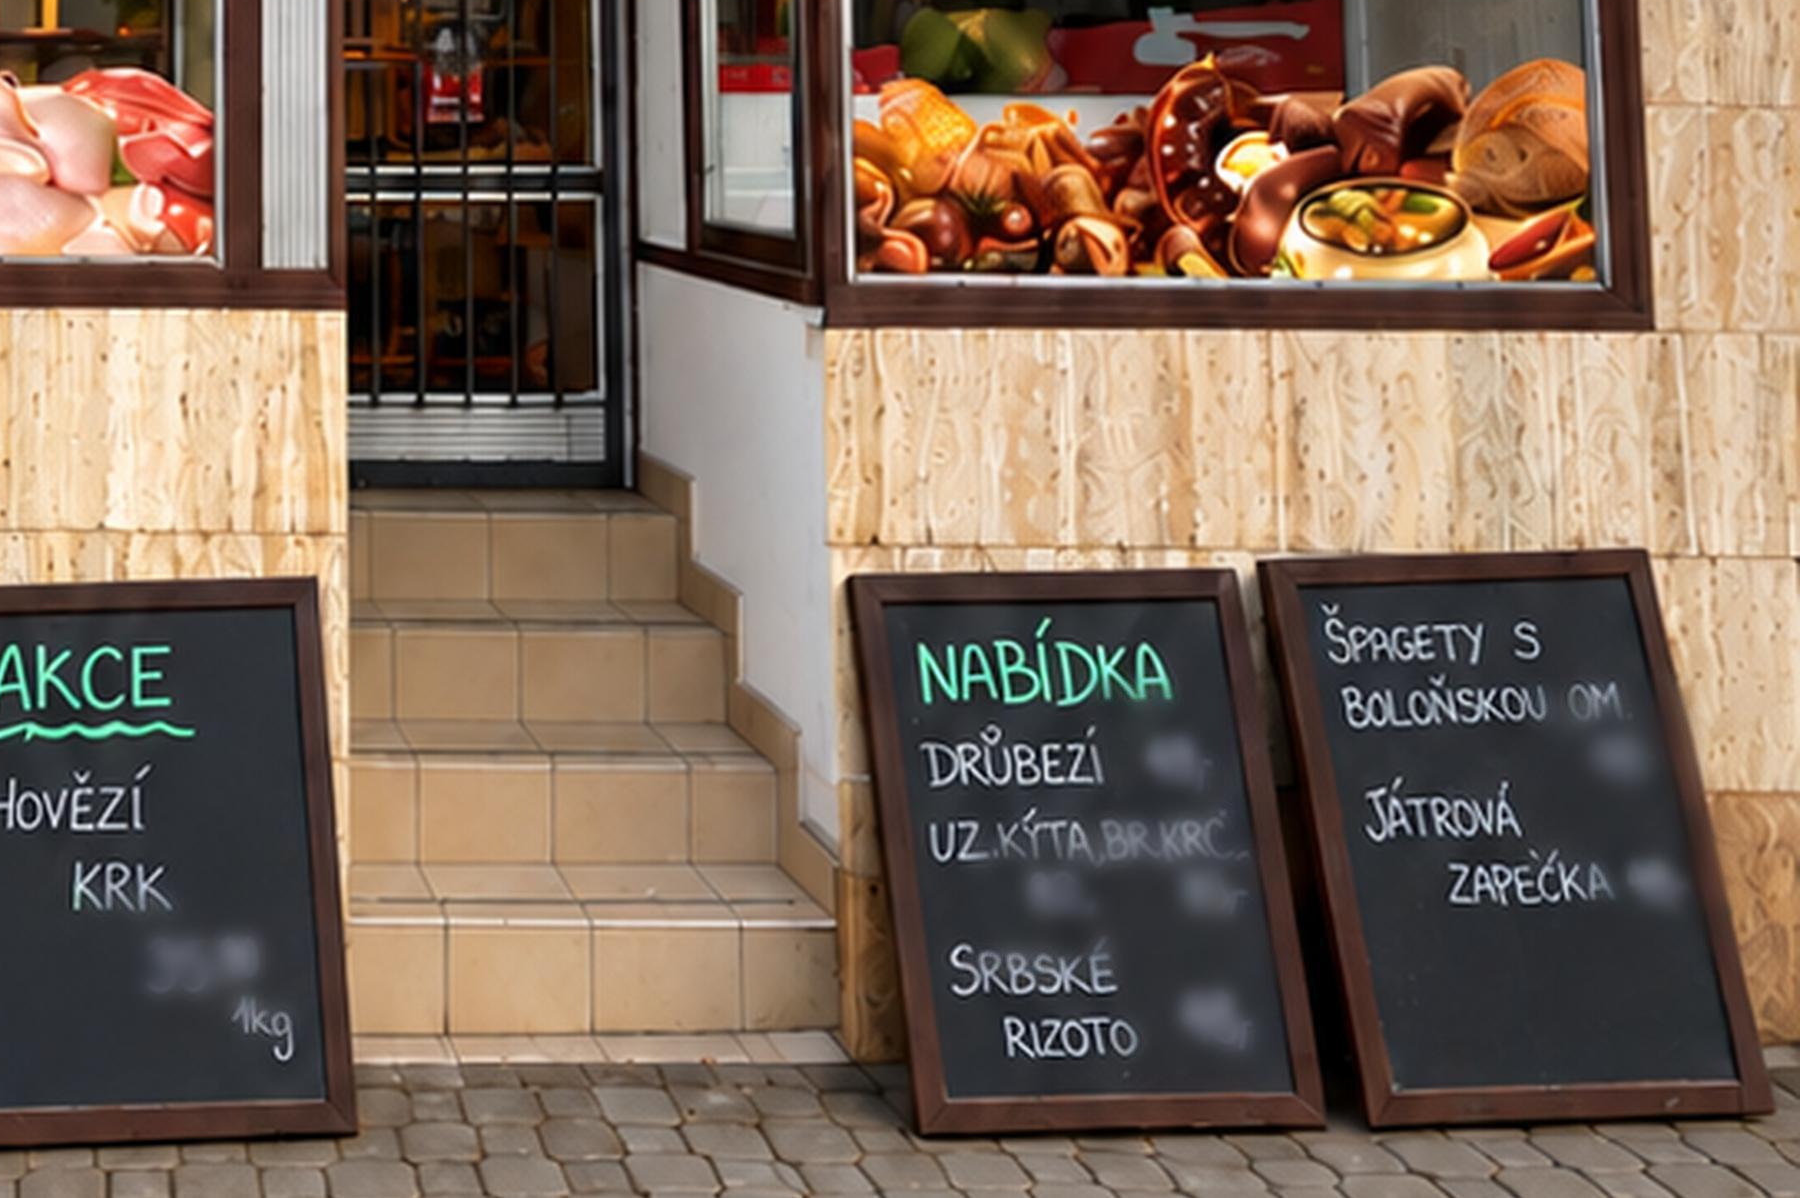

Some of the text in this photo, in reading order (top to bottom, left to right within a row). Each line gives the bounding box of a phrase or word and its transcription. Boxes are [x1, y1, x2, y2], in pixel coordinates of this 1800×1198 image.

[917, 617, 1173, 706] NABÍDKA
[1321, 604, 1541, 665] ŠPAGETY S
[1340, 673, 1548, 729] BOLOŇSKOU
[1364, 776, 1523, 843] JÁTROVÁ
[72, 860, 173, 912] KRK
[949, 938, 1118, 997] SRBSKÉ
[231, 995, 294, 1062] 1kg
[1003, 1016, 1138, 1059] RIZOTO
